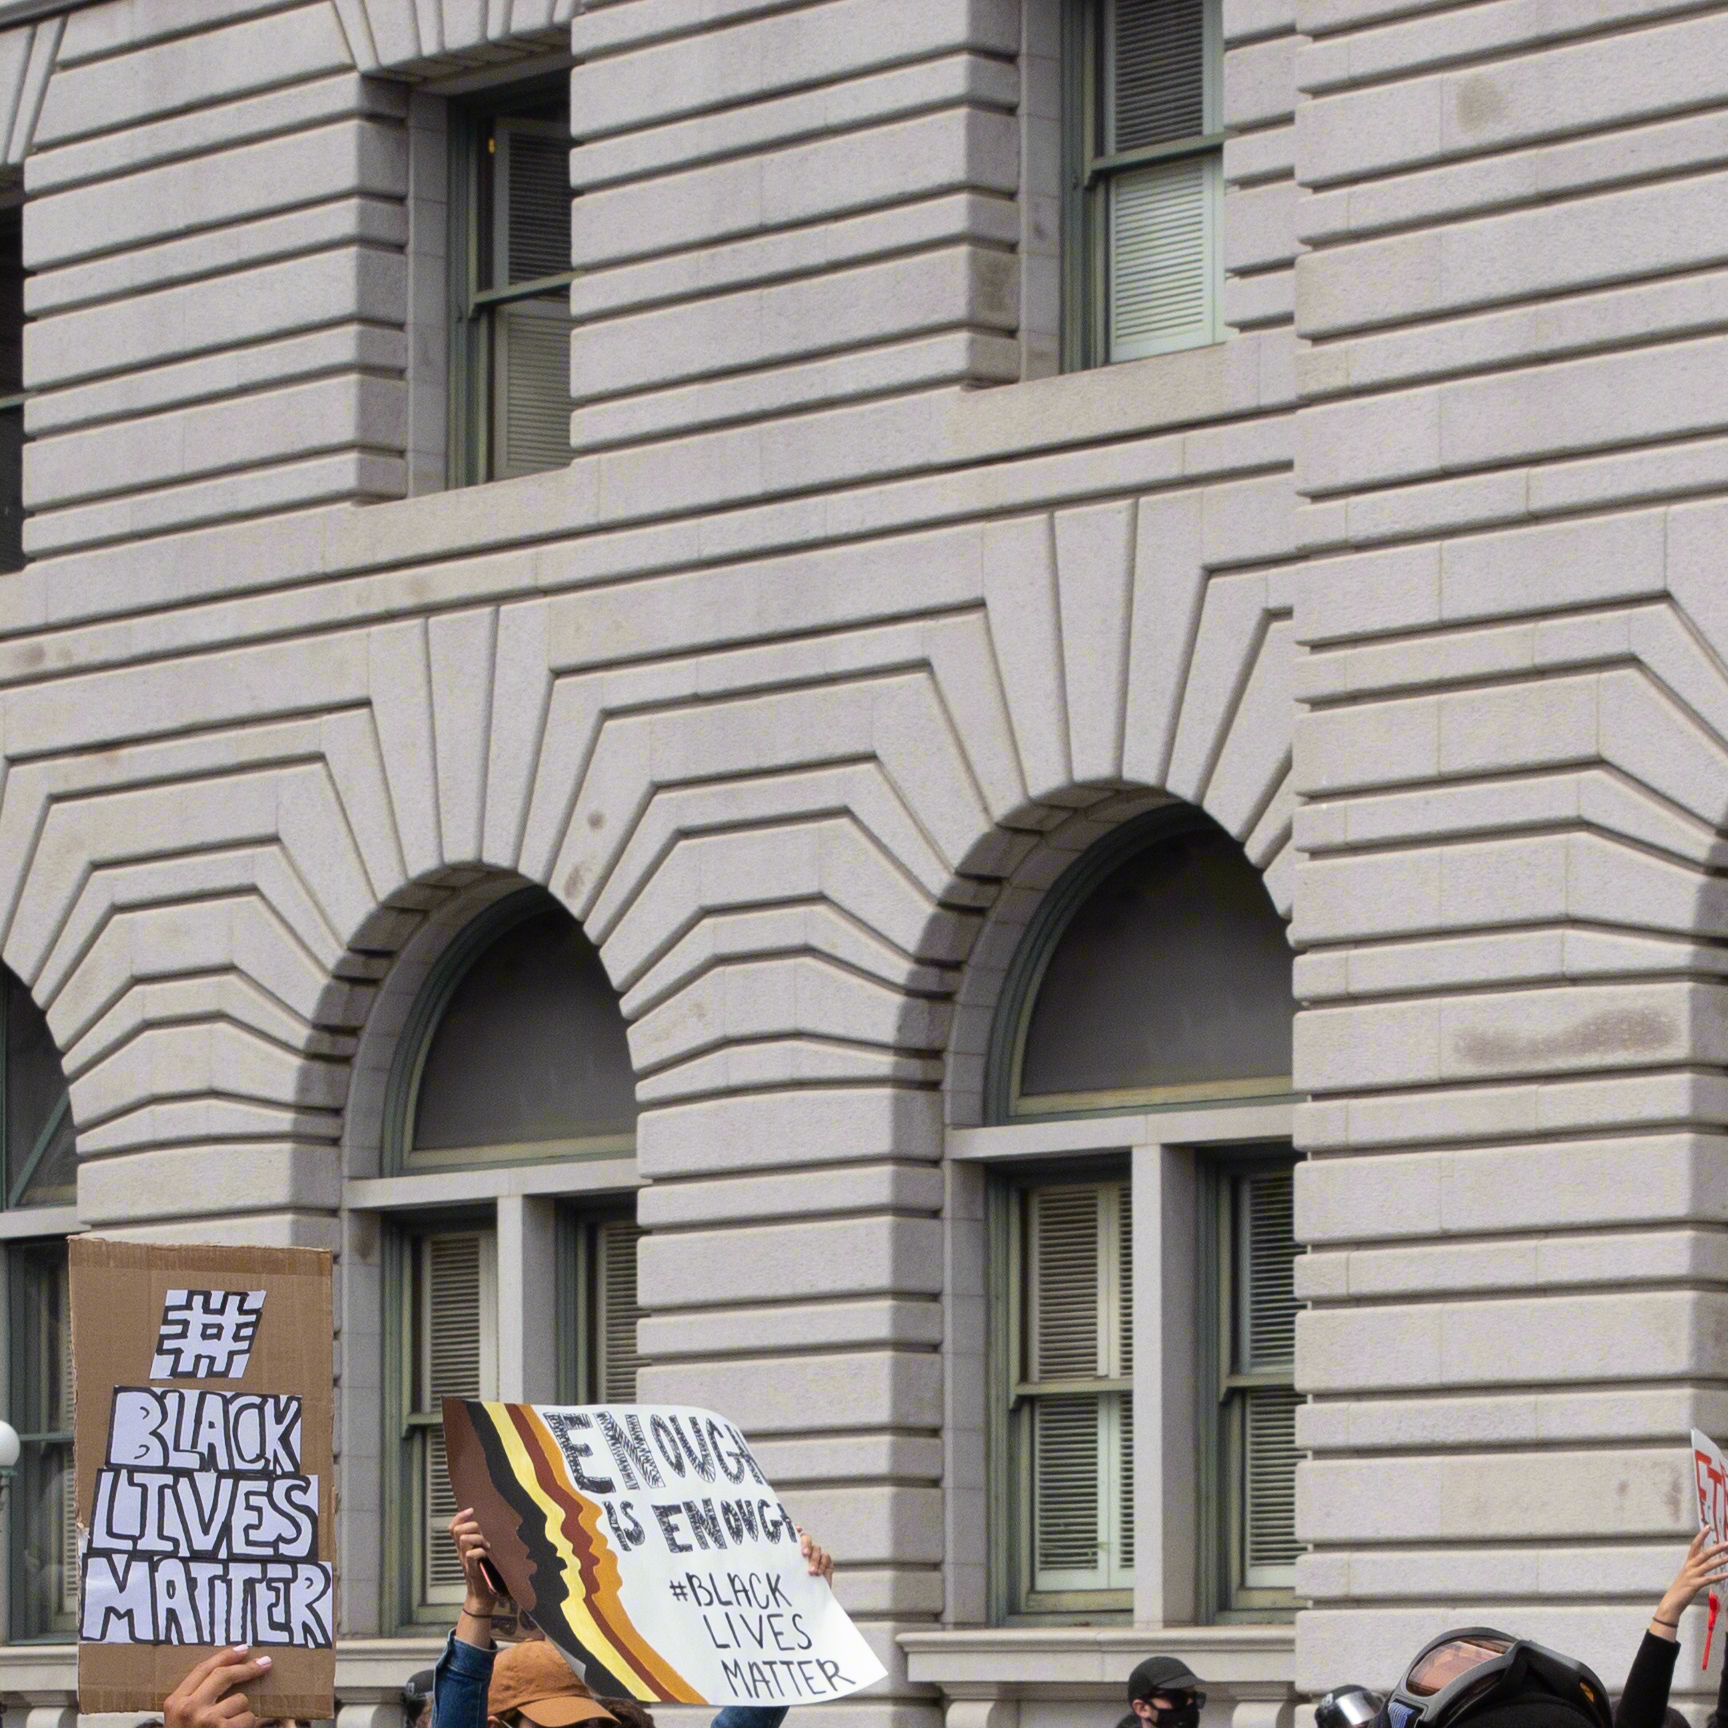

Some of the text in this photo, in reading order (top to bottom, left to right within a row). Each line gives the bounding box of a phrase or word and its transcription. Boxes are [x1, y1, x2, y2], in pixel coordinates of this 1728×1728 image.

[149, 1290, 266, 1379] #
[105, 1385, 302, 1477] BLACK
[88, 1468, 318, 1562] LIVES
[603, 1500, 645, 1552] IS
[80, 1552, 333, 1648] MATTER
[669, 1572, 792, 1609] #BLACK
[704, 1612, 812, 1650] LIVES
[722, 1659, 856, 1699] MATTER
